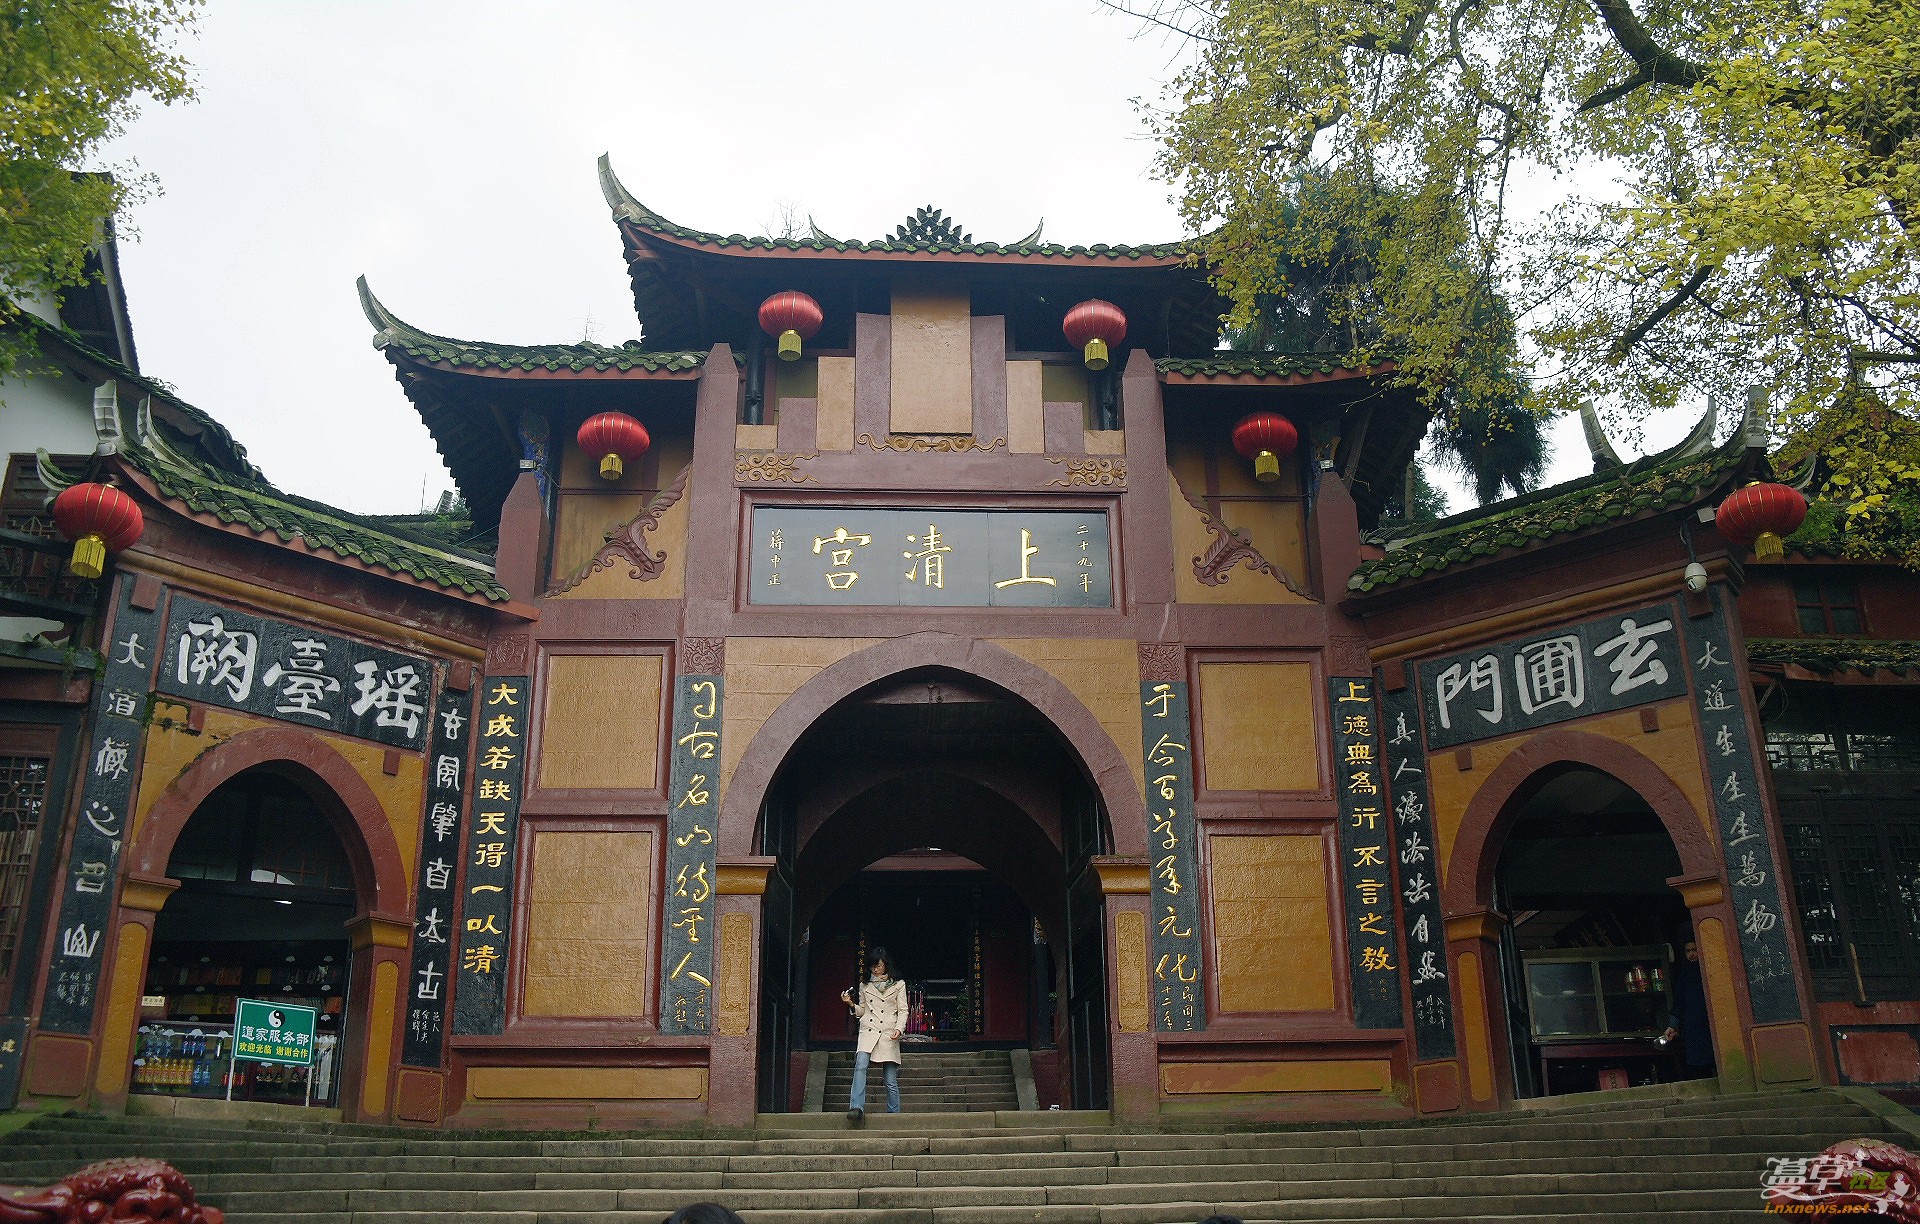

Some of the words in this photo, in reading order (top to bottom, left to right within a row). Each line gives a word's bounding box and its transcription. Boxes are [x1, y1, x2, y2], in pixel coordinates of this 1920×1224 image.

[241, 1025, 310, 1047] 道家服务部
[238, 1041, 273, 1055] 欢迎光临
[276, 1046, 309, 1059] 谢谢合作
